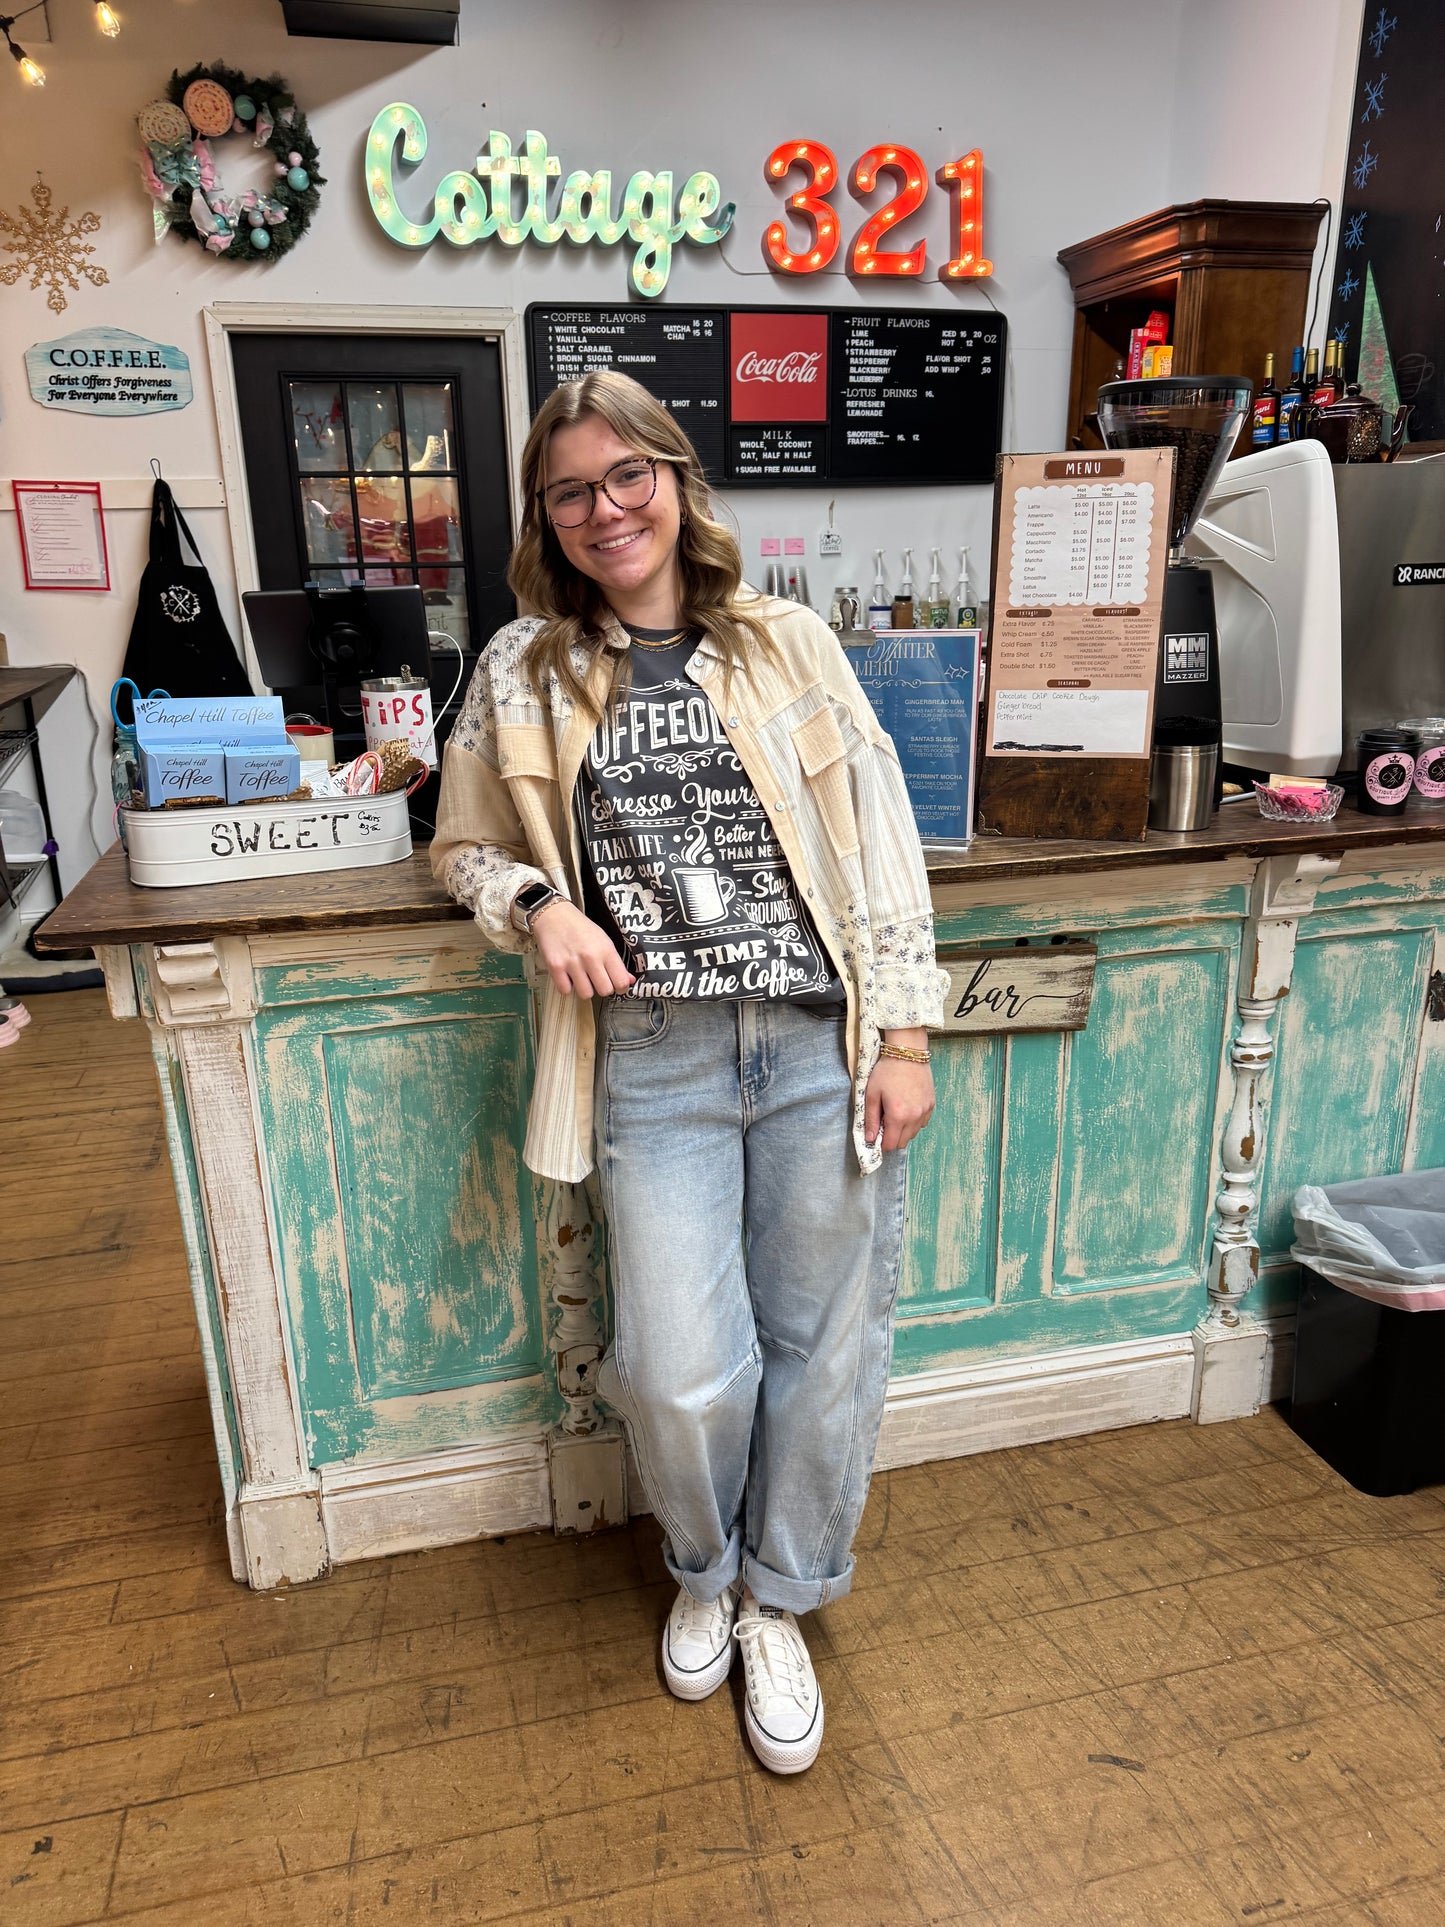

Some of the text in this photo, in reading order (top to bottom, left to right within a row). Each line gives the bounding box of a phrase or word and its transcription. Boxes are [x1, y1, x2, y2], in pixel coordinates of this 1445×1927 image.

[365, 102, 995, 298] Cottage 321
[551, 313, 646, 323] COFFEE FLAVORS
[852, 318, 930, 328] FRUIT FLAVORS
[664, 325, 690, 333] MATCHA
[984, 335, 997, 343] OZ
[50, 349, 166, 368] C.O.F.F.E.E.
[736, 351, 822, 382] Coca-Cola
[49, 374, 171, 389] Christ Offers Forgiveness
[48, 390, 178, 403] For Everyone Everywhere
[847, 389, 917, 397] LOTUS DRINKS
[763, 431, 792, 439] MILK
[740, 441, 766, 449] WHOLE,
[741, 452, 758, 460] OAT,
[1066, 462, 1100, 475] MENU
[856, 660, 899, 677] MENU
[146, 707, 274, 727] Chapel Hill Toffee
[167, 759, 192, 767] Chapel
[245, 760, 268, 768] Chapel
[161, 769, 213, 790] Toffee
[240, 770, 289, 790] Toffee
[211, 814, 349, 856] SWEET
[715, 824, 756, 845] Better
[590, 835, 666, 862] TAKE LIFE
[719, 846, 753, 860] THAN
[638, 861, 665, 889] cup
[752, 871, 790, 898] Stay
[609, 890, 644, 911] AT A
[744, 899, 797, 924] GROUNDED
[693, 940, 767, 967] TIME
[774, 939, 809, 958] TO
[698, 968, 740, 996] the
[743, 959, 807, 997] Coffee
[954, 958, 1084, 1018] bar
